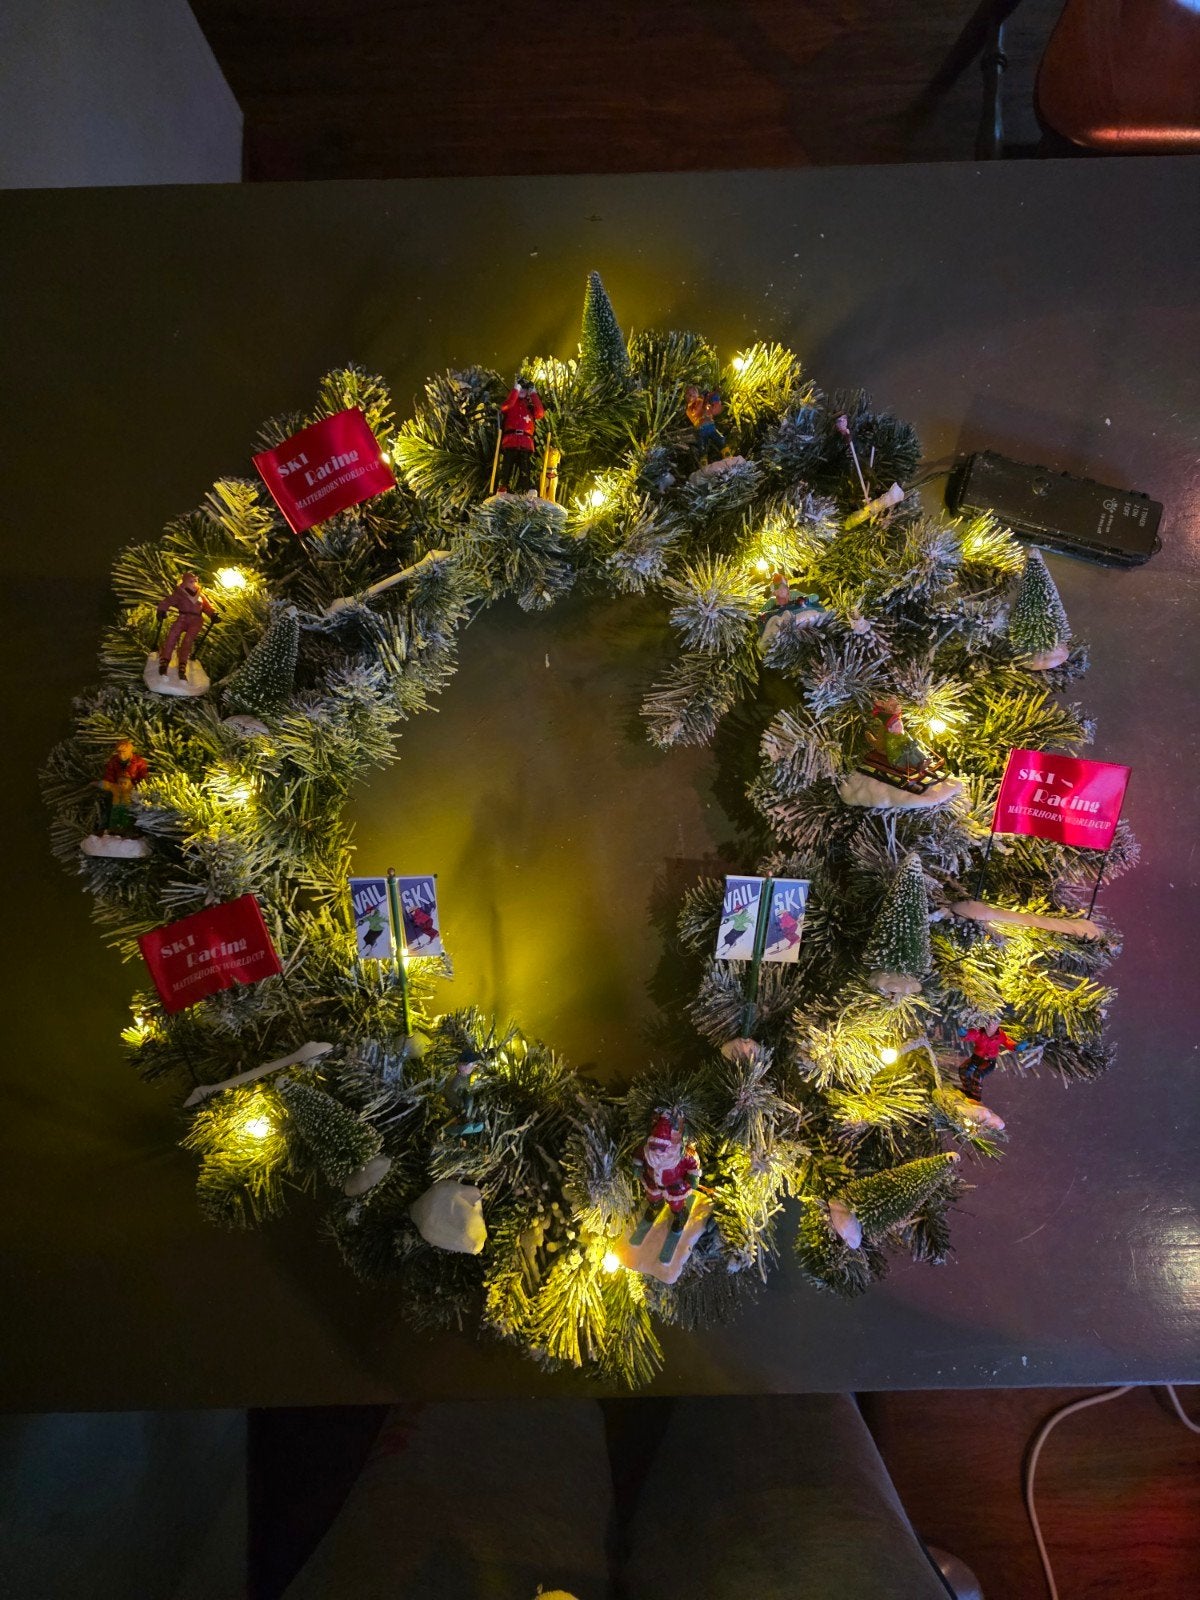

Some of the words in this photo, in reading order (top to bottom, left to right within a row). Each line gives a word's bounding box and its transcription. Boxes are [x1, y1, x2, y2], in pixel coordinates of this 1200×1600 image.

[277, 452, 309, 478] SKI
[304, 449, 359, 487] Racing
[295, 480, 340, 511] MATTERHORN
[339, 466, 365, 485] WORLD
[364, 460, 380, 474] CUP
[1018, 768, 1056, 785] SKI
[1033, 788, 1100, 814] Racing
[1008, 805, 1063, 823] MATTERHORN
[1064, 815, 1095, 829] WORLD
[1094, 820, 1112, 830] CUP
[353, 884, 387, 915] VAIL
[401, 882, 435, 915] SKI
[723, 883, 760, 914] VAIL
[773, 886, 806, 917] SKI
[160, 934, 195, 959] SKI
[186, 938, 248, 968] Racing
[172, 964, 221, 993] MATTERHORN
[222, 955, 251, 970] WORLD
[249, 950, 265, 963] CUP
